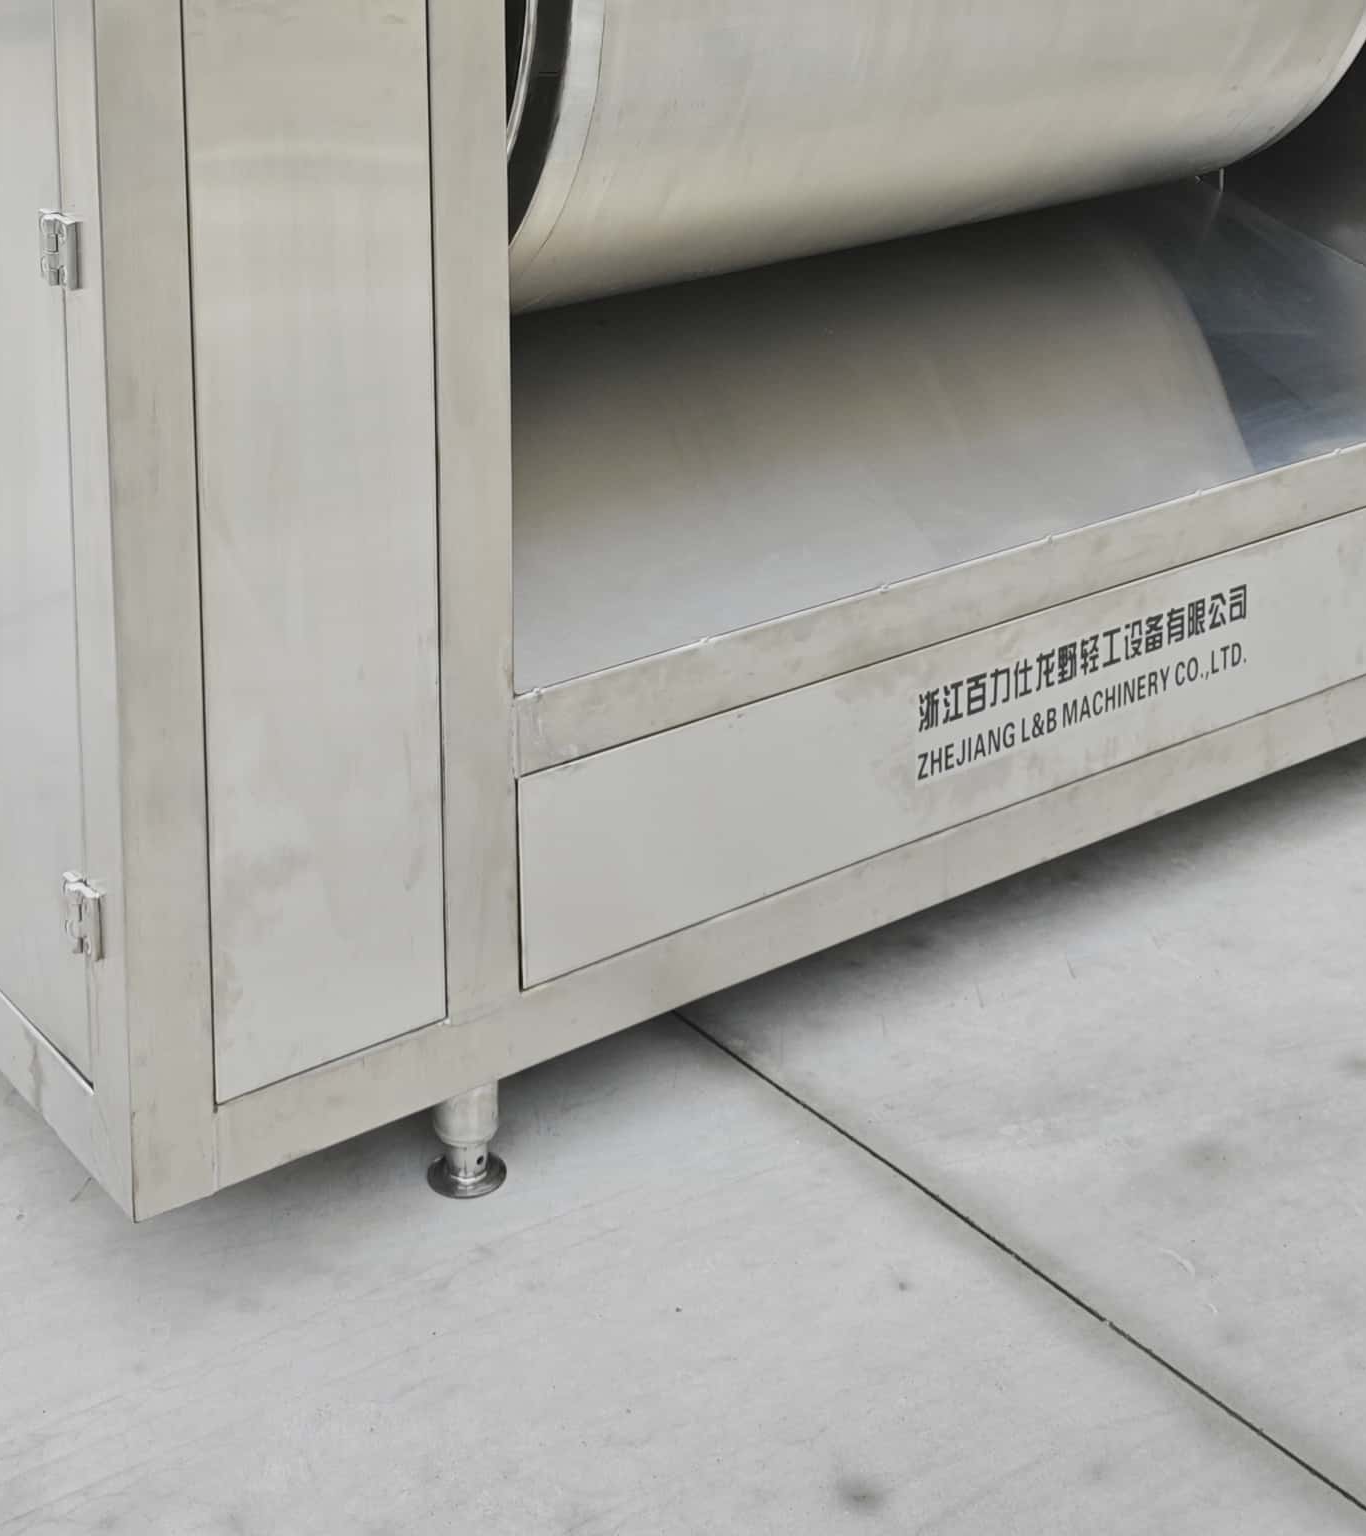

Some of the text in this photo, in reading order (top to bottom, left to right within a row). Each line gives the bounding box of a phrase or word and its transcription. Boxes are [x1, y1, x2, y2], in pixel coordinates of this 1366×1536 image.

[917, 723, 1015, 780] ZHEJIANG
[1021, 707, 1058, 744] L&B
[1062, 666, 1170, 728] MACHINERY
[918, 583, 1247, 732] 浙江百力仕龙野轻工设备有限公司
